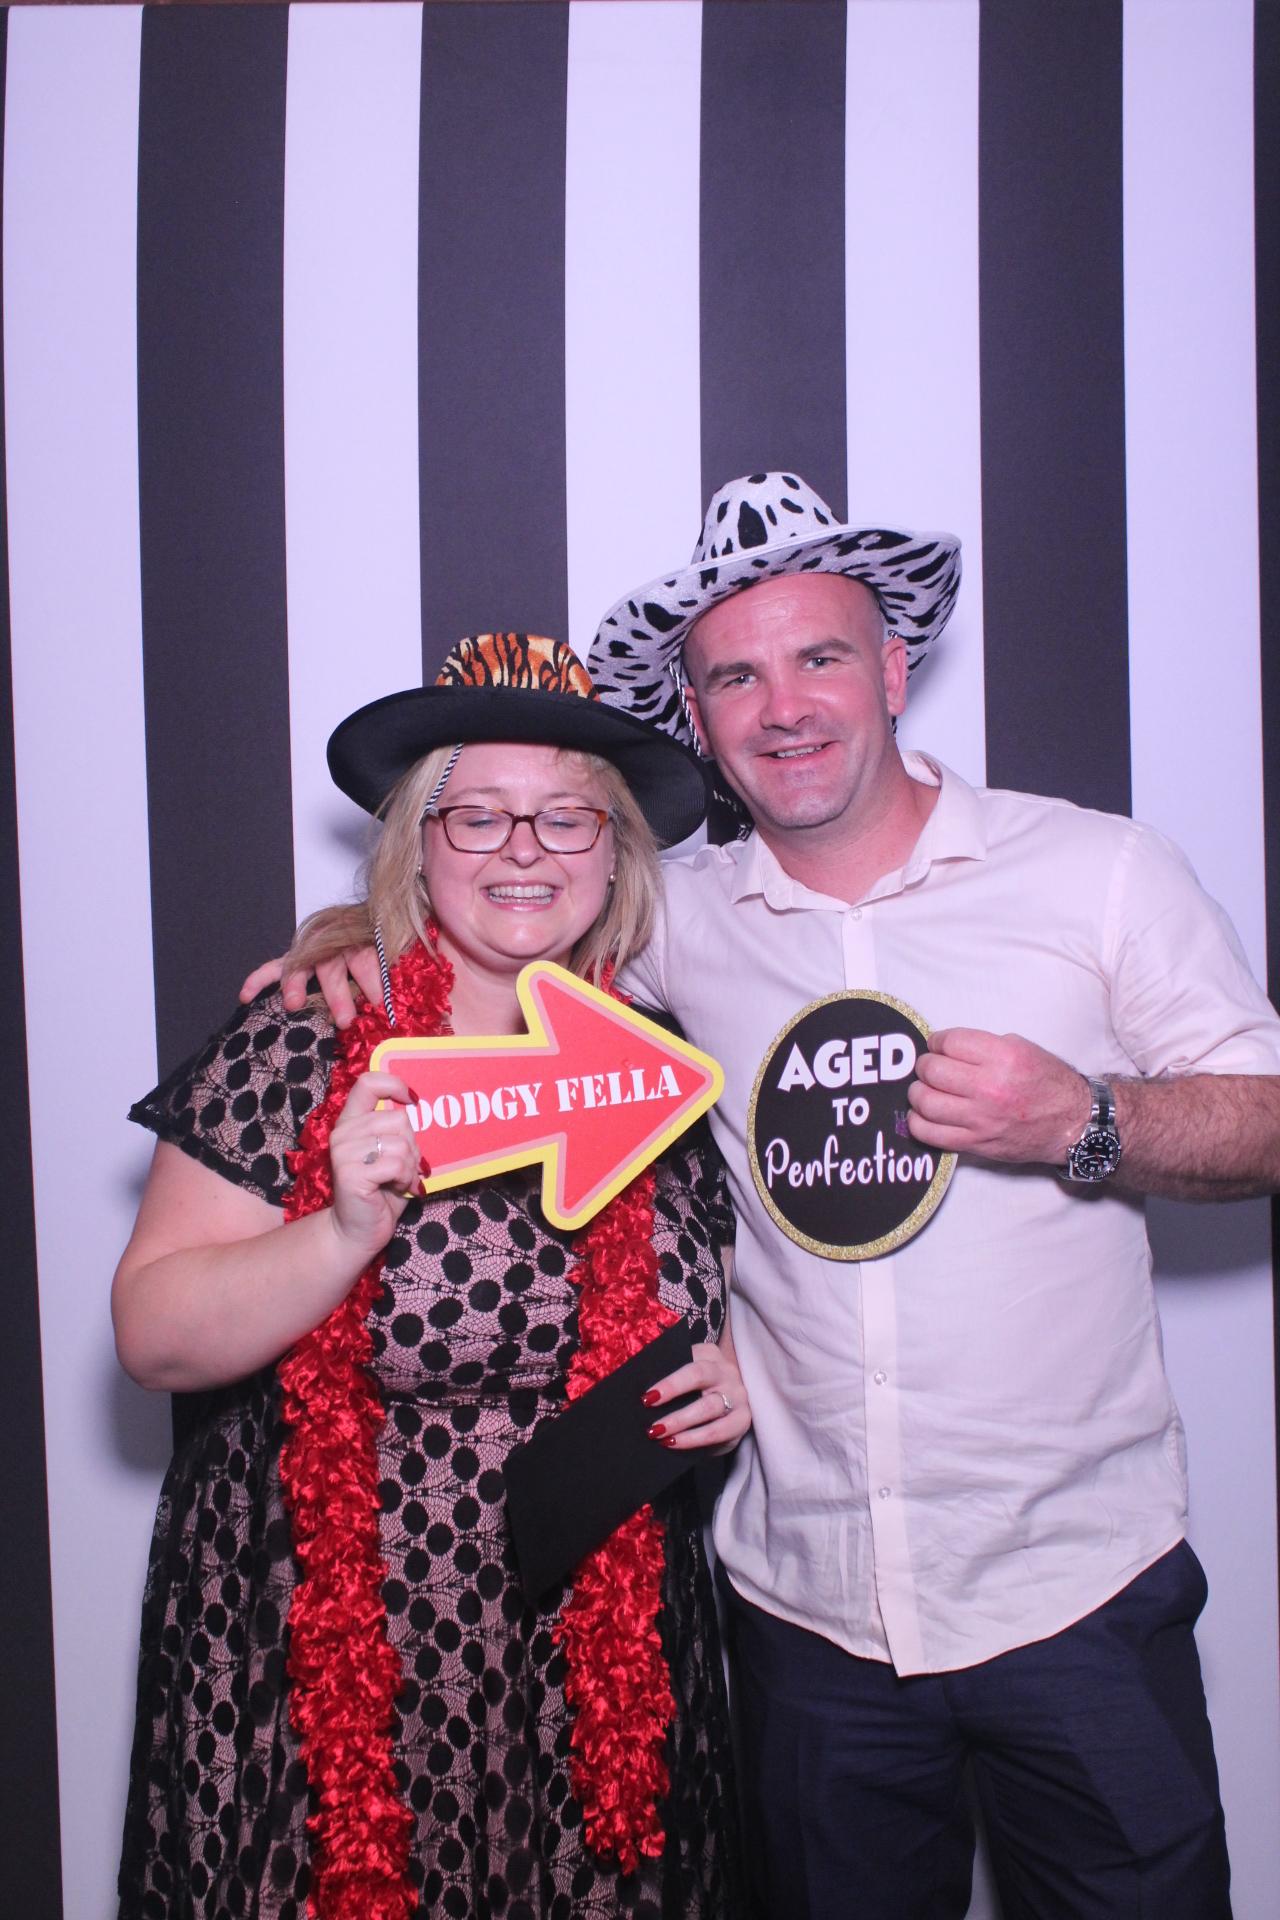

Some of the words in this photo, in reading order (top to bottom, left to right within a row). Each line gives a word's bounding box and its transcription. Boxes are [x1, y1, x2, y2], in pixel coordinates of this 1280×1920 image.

[776, 1033, 917, 1093] AGED
[406, 1082, 542, 1132] DODGY
[555, 1064, 682, 1112] FELLA
[832, 1097, 870, 1126] TO
[765, 1130, 934, 1189] Perfection
